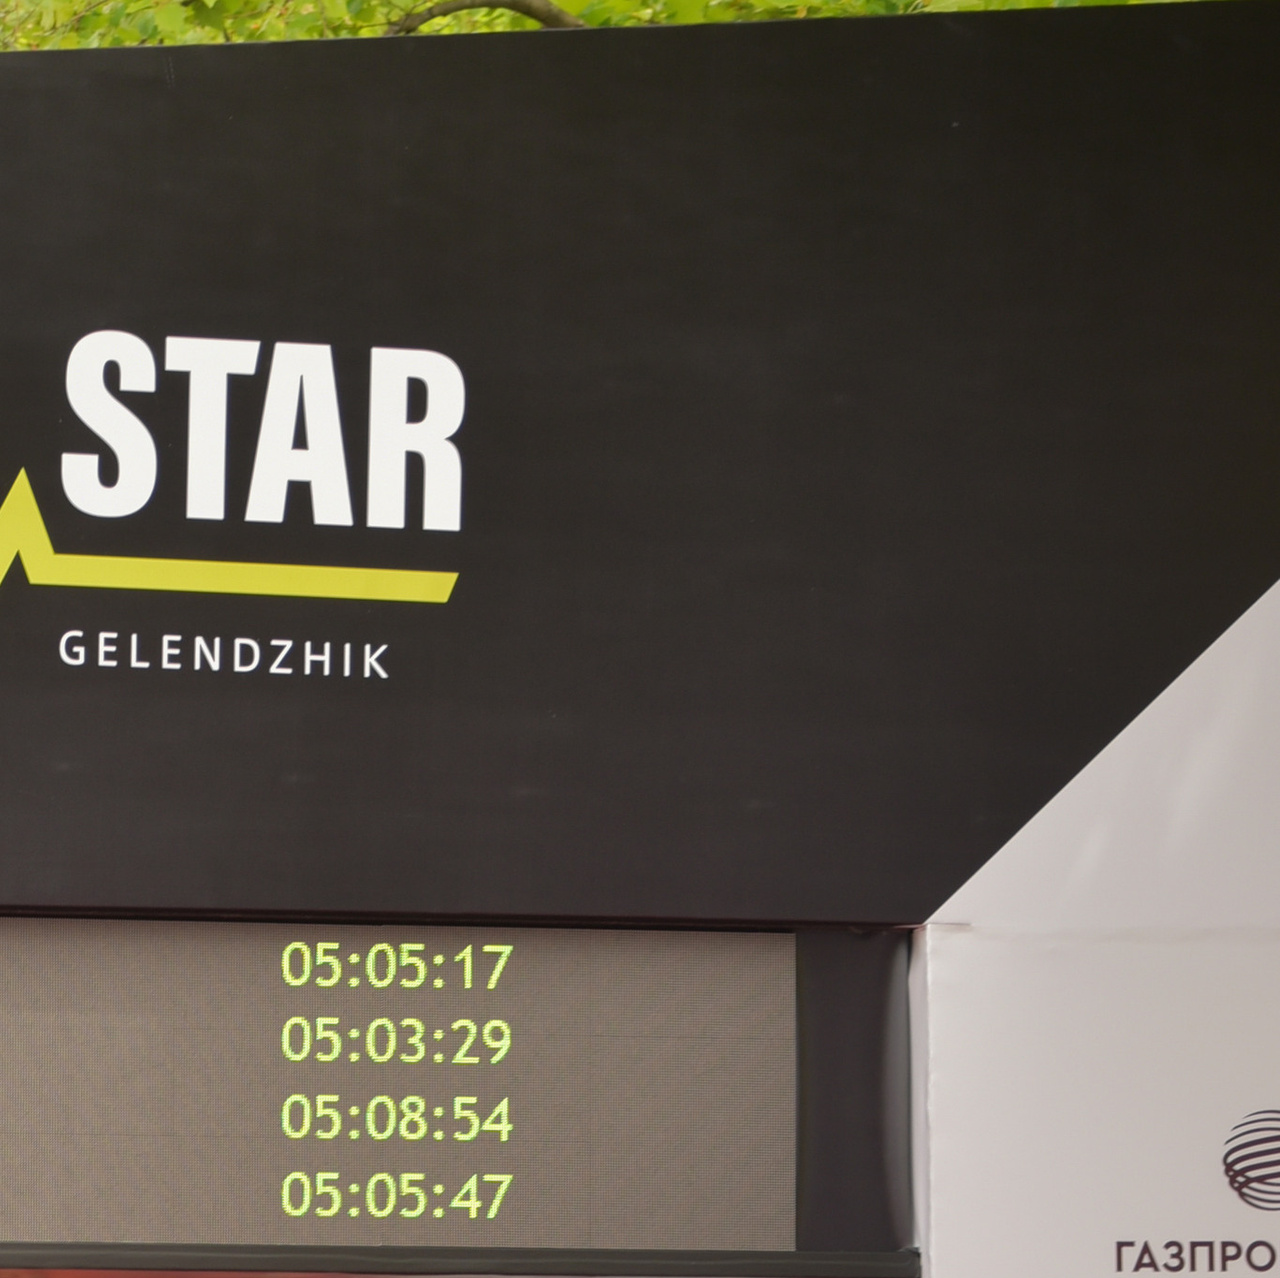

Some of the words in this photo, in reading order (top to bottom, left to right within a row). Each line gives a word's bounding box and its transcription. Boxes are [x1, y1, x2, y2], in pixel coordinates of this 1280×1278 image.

[60, 328, 467, 532] STAR
[58, 629, 391, 680] GELENDZHIK
[280, 941, 515, 990] 05:05:17
[280, 1016, 515, 1064] 05:03:29
[280, 1093, 515, 1143] 05:08:54
[280, 1170, 515, 1220] 05:05:47
